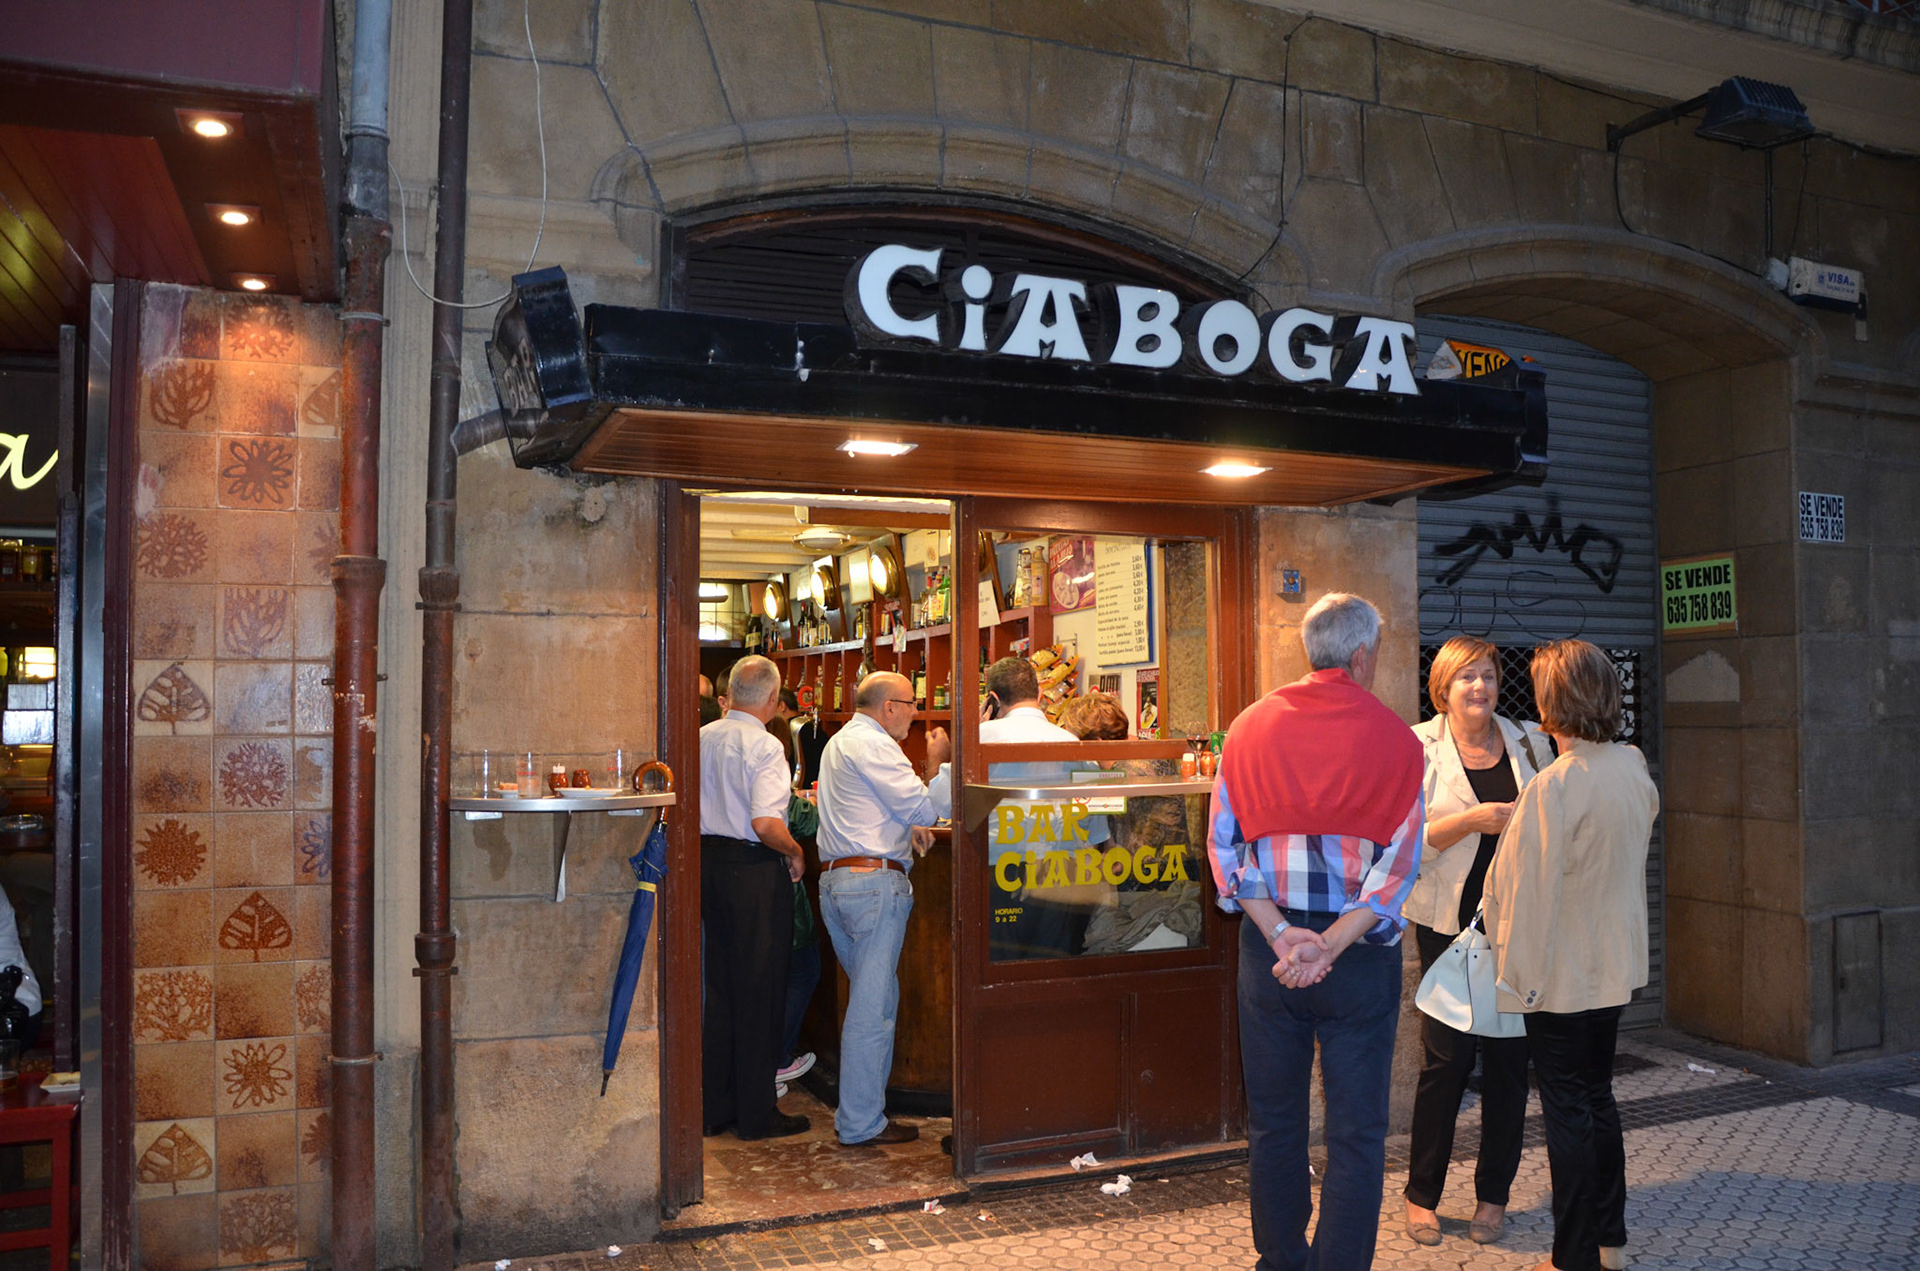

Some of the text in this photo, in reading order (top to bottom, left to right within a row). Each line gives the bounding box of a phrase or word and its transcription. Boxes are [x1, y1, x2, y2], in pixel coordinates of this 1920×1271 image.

[1827, 271, 1850, 286] VISA
[1800, 494, 1844, 519] SE VENDE
[1800, 516, 1844, 541] 635 758 839
[1665, 564, 1731, 591] SE VENDE
[1667, 590, 1732, 624] 635 758 839
[995, 803, 1090, 844] BAR
[994, 907, 1024, 915] HORARIO
